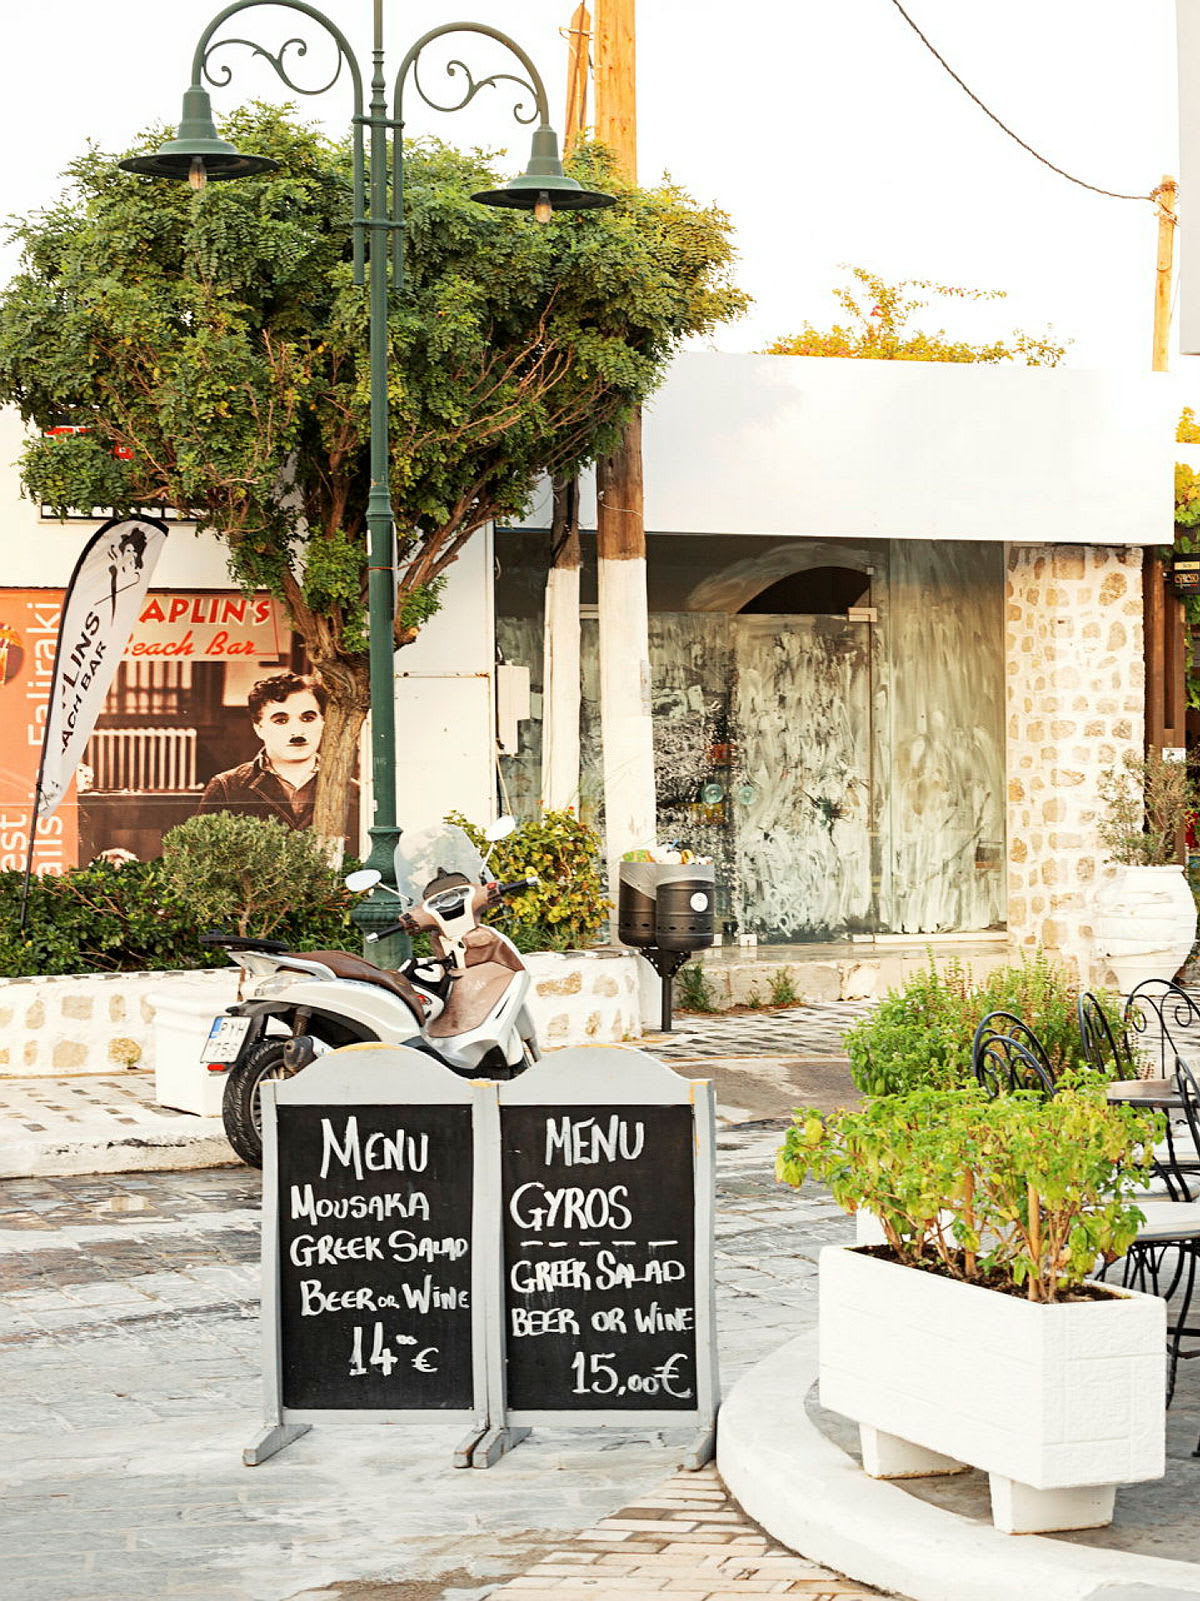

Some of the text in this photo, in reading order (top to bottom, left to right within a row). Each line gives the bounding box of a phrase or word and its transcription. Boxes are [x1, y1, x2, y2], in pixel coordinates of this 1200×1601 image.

[139, 598, 271, 624] APLIN'S
[62, 612, 100, 706] LINS
[205, 631, 257, 656] Bar
[26, 603, 61, 745] Faliraki
[61, 641, 108, 755] ACH BAR
[0, 814, 27, 873] est
[33, 816, 64, 880] ails
[545, 1114, 644, 1166] MENU
[509, 1181, 632, 1231] GYROS
[510, 1250, 686, 1293] GREEK SALAD
[511, 1307, 580, 1337] BEER
[591, 1307, 627, 1334] OR
